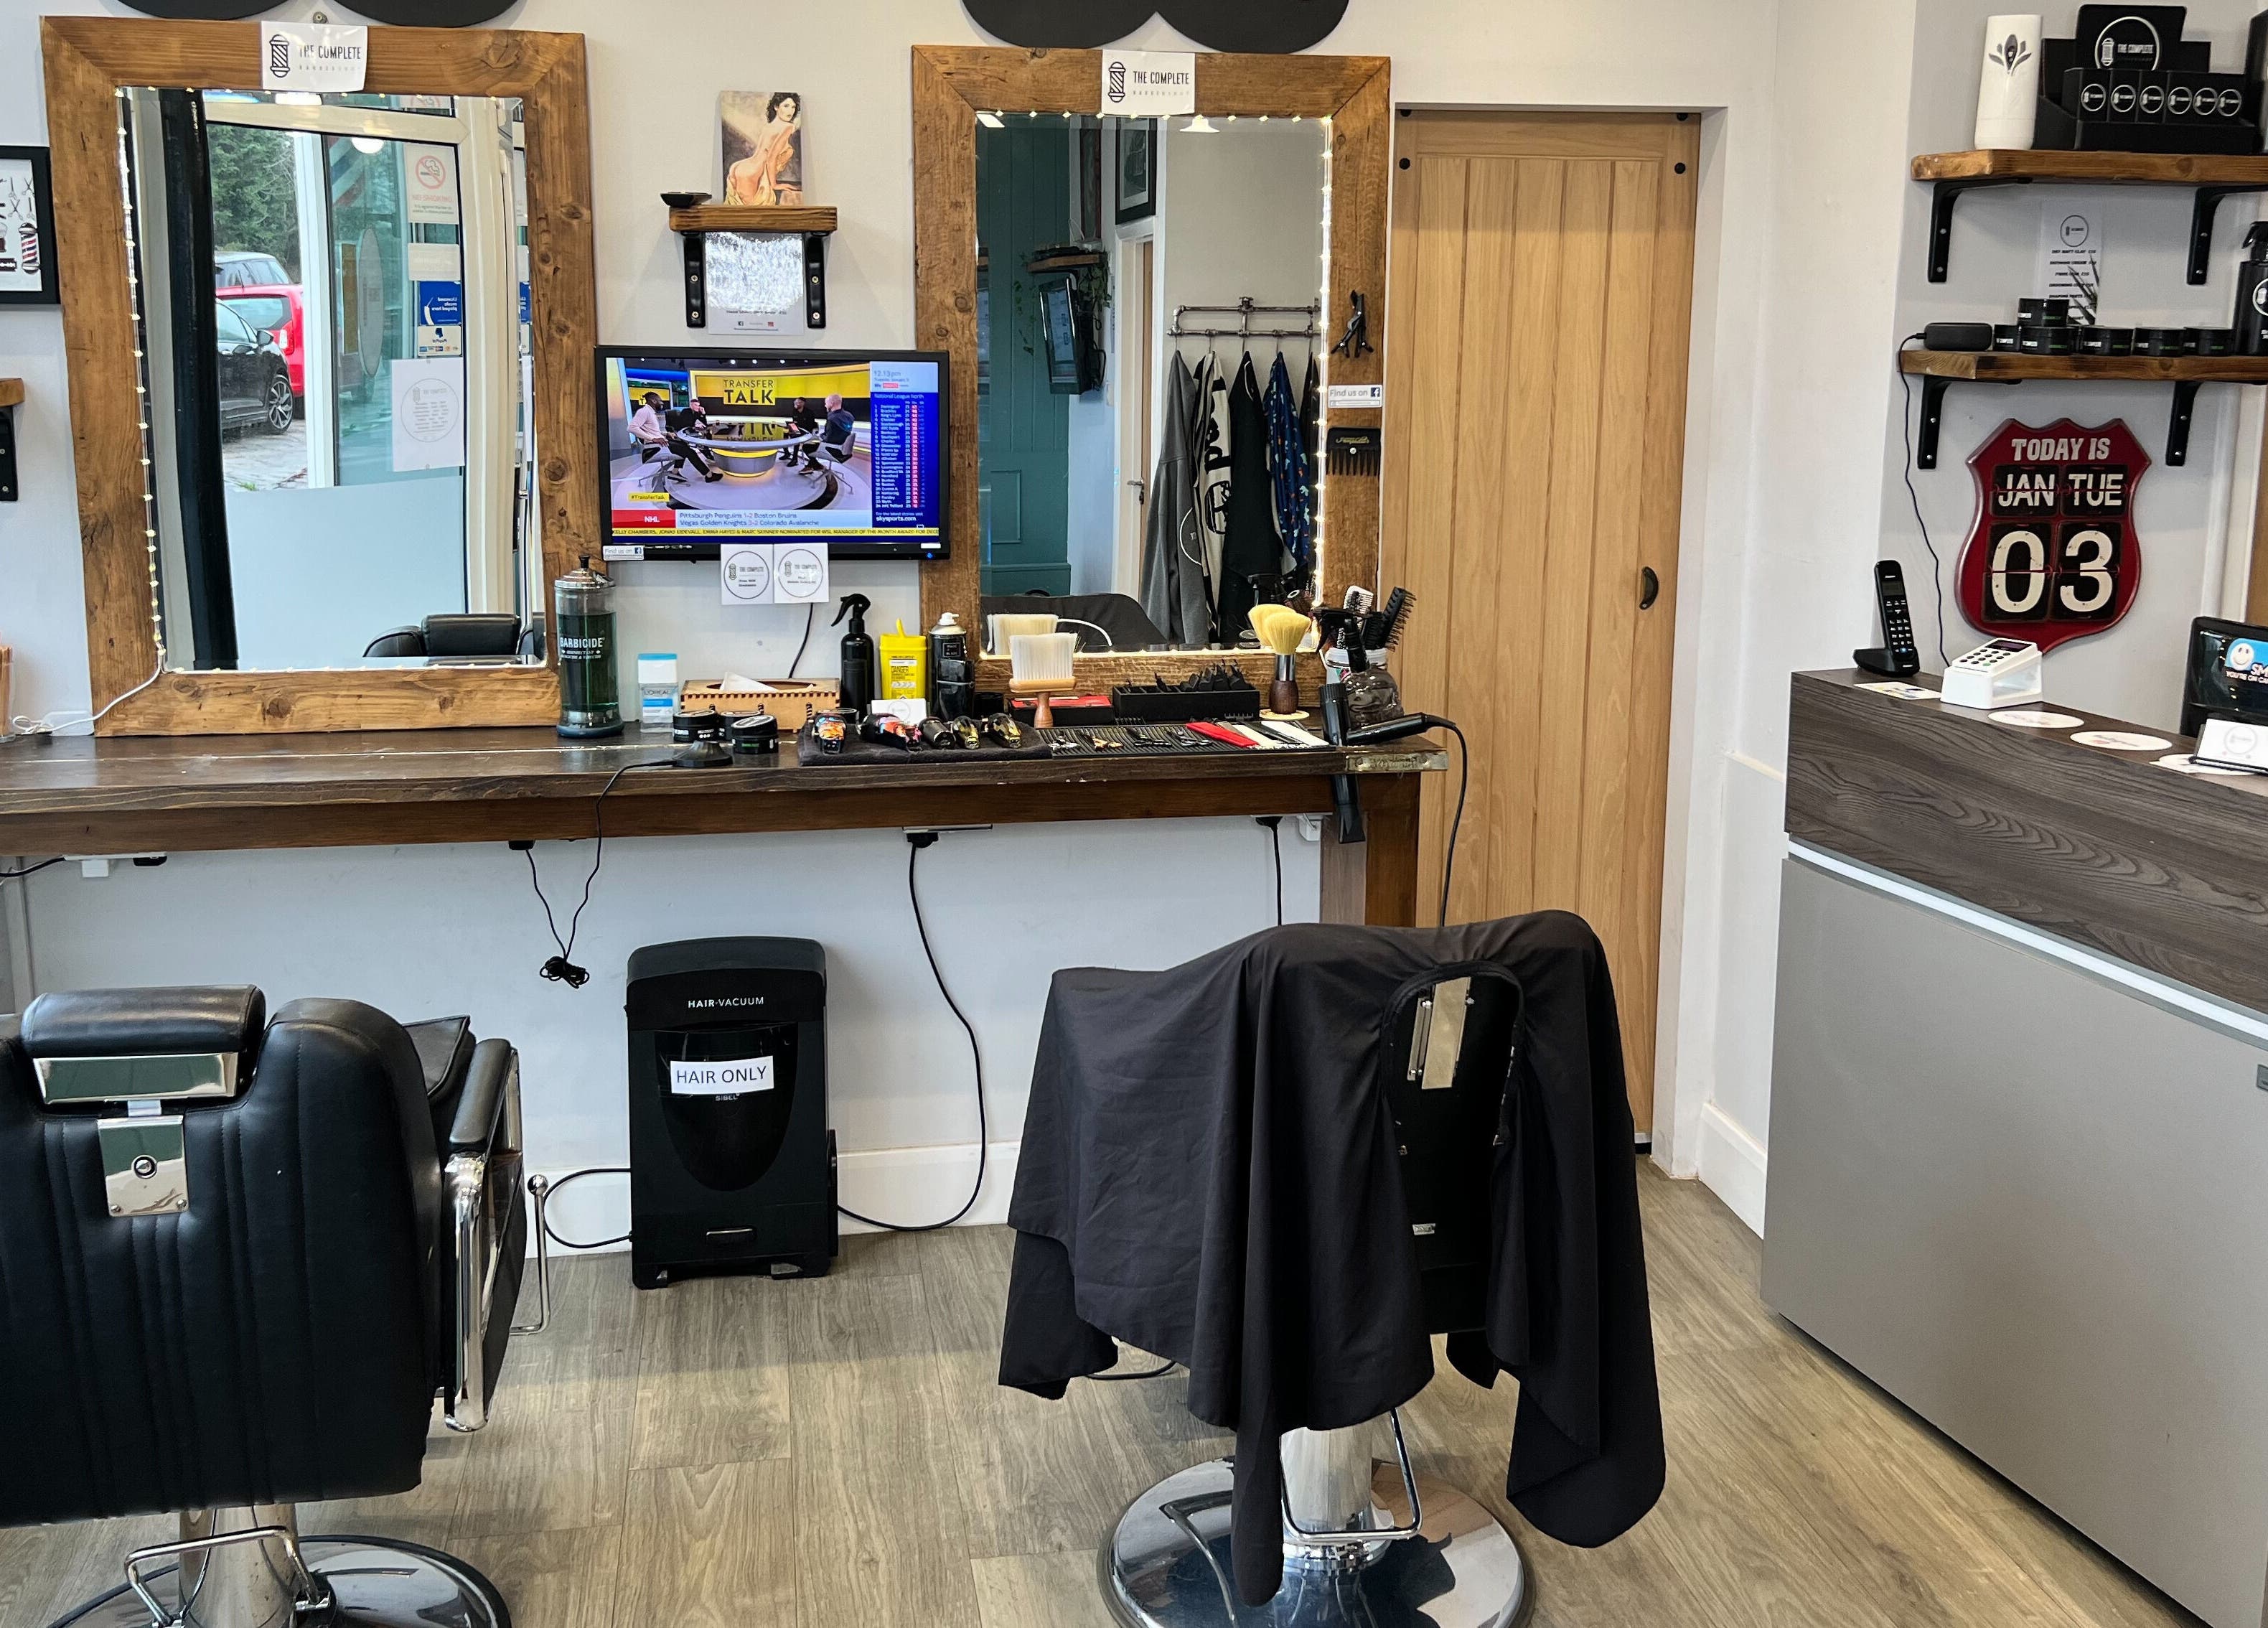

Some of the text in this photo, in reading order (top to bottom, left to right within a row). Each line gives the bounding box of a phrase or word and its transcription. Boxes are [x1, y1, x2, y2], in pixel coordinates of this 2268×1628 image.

[318, 46, 361, 59] COMPLETE
[2128, 45, 2153, 53] COMPLETE
[1133, 70, 1189, 85] THE COMPLETE
[723, 379, 774, 388] TRANSFER
[724, 389, 774, 403] TALK
[2012, 438, 2110, 461] TODAY IS
[1998, 474, 2124, 506] JAN TUE
[560, 637, 602, 648] BARBICIDE
[2226, 670, 2247, 681] YOU'RE
[677, 1066, 767, 1084] HAIR ONLY
